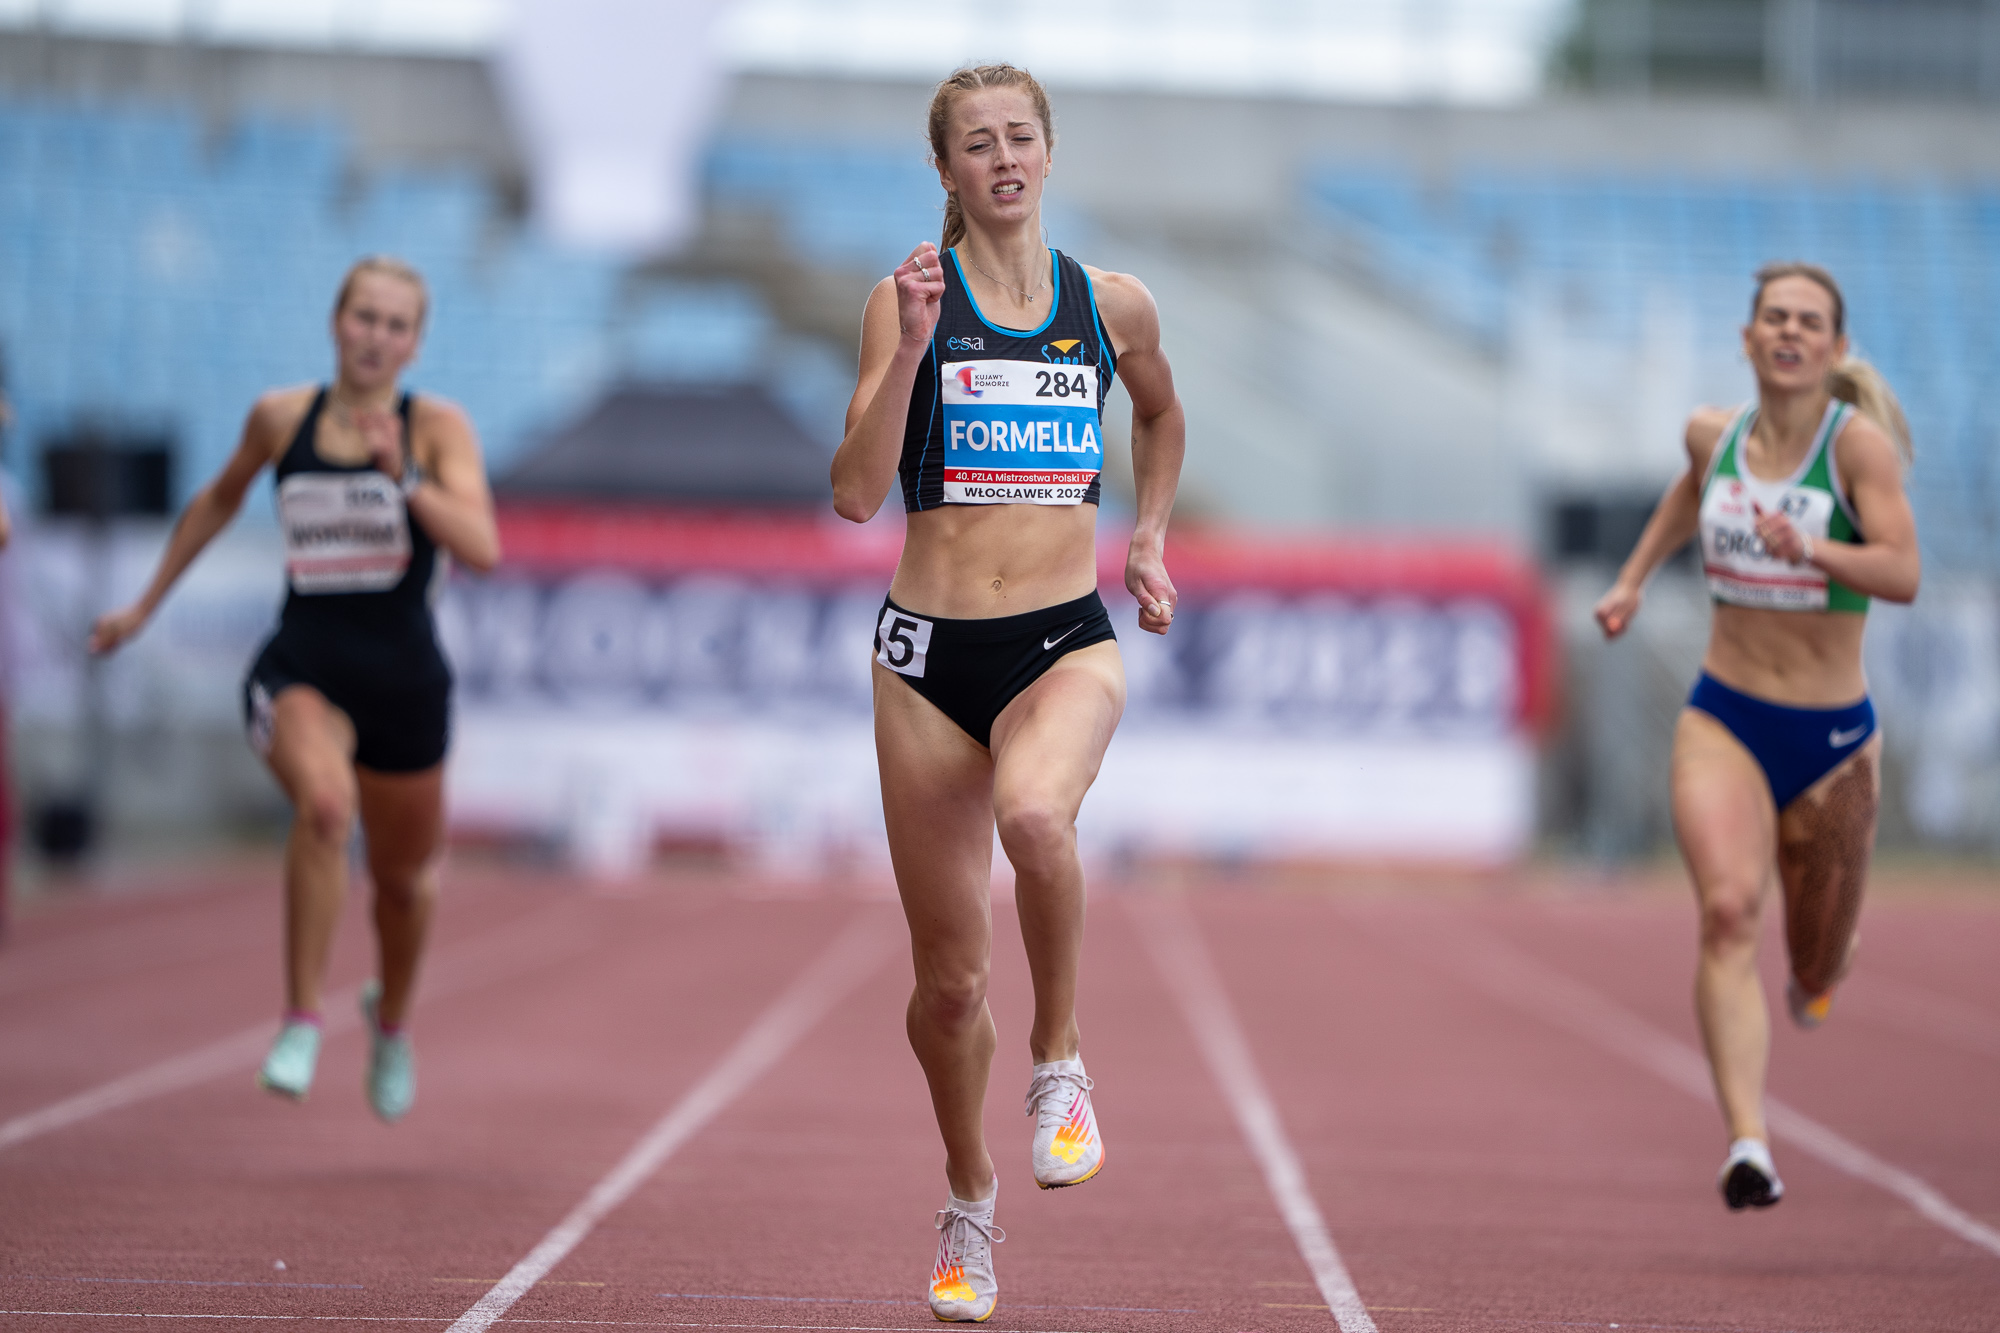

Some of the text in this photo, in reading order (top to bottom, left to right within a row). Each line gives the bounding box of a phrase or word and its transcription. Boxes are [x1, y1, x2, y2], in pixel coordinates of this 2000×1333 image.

[1035, 370, 1088, 399] 284
[950, 420, 1100, 454] FORMELLA
[955, 471, 1096, 483] 40. PZLA Mistrzostwa Polski U2
[964, 486, 1053, 499] WŁOCŁAWEK
[887, 616, 919, 668] 5
